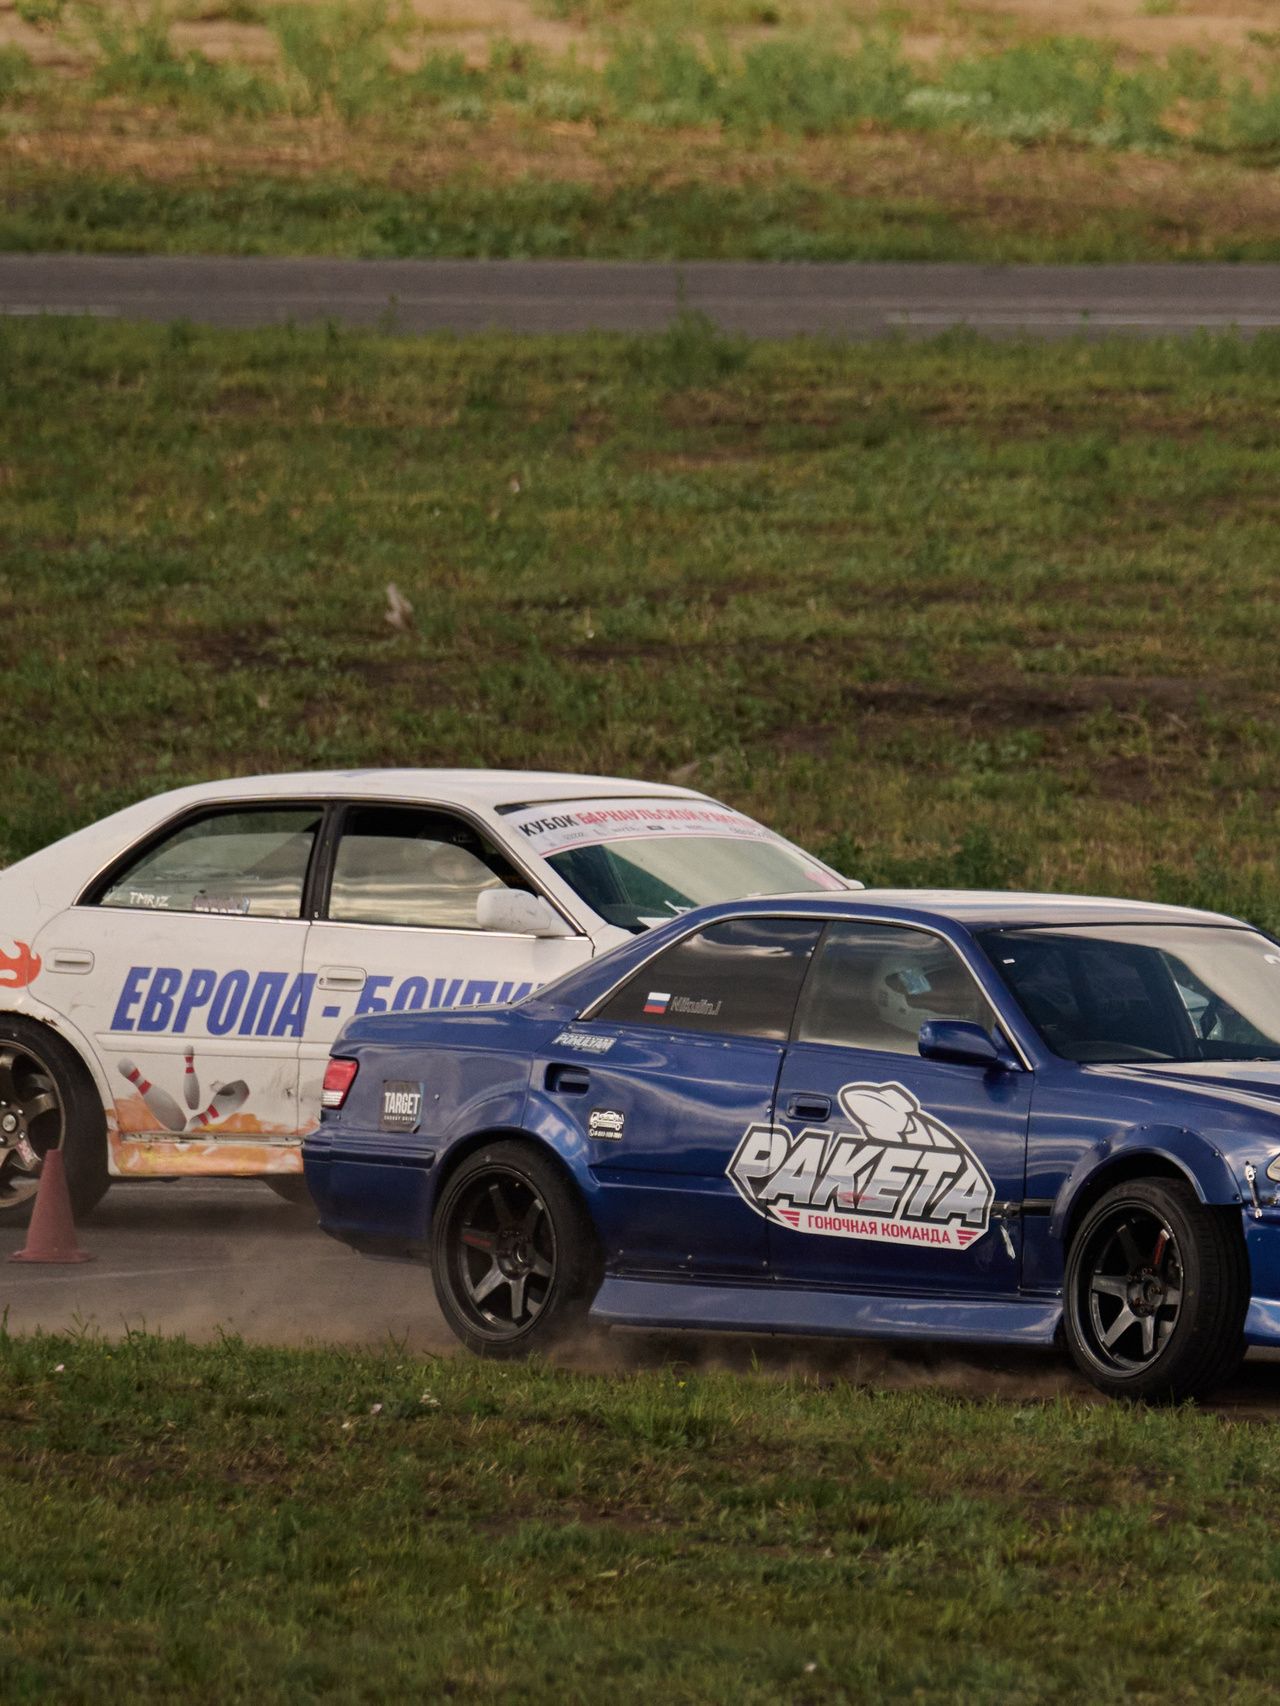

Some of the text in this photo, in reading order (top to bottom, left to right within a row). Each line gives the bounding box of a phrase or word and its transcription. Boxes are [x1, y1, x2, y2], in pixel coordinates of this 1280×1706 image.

[519, 814, 579, 837] КУБОК
[110, 966, 319, 1038] ЕВРОПА
[384, 1091, 421, 1115] TARGET
[733, 1130, 989, 1224] РАКЕТА
[807, 1214, 951, 1245] ГОНОЧНАЯ КОМАНДА
